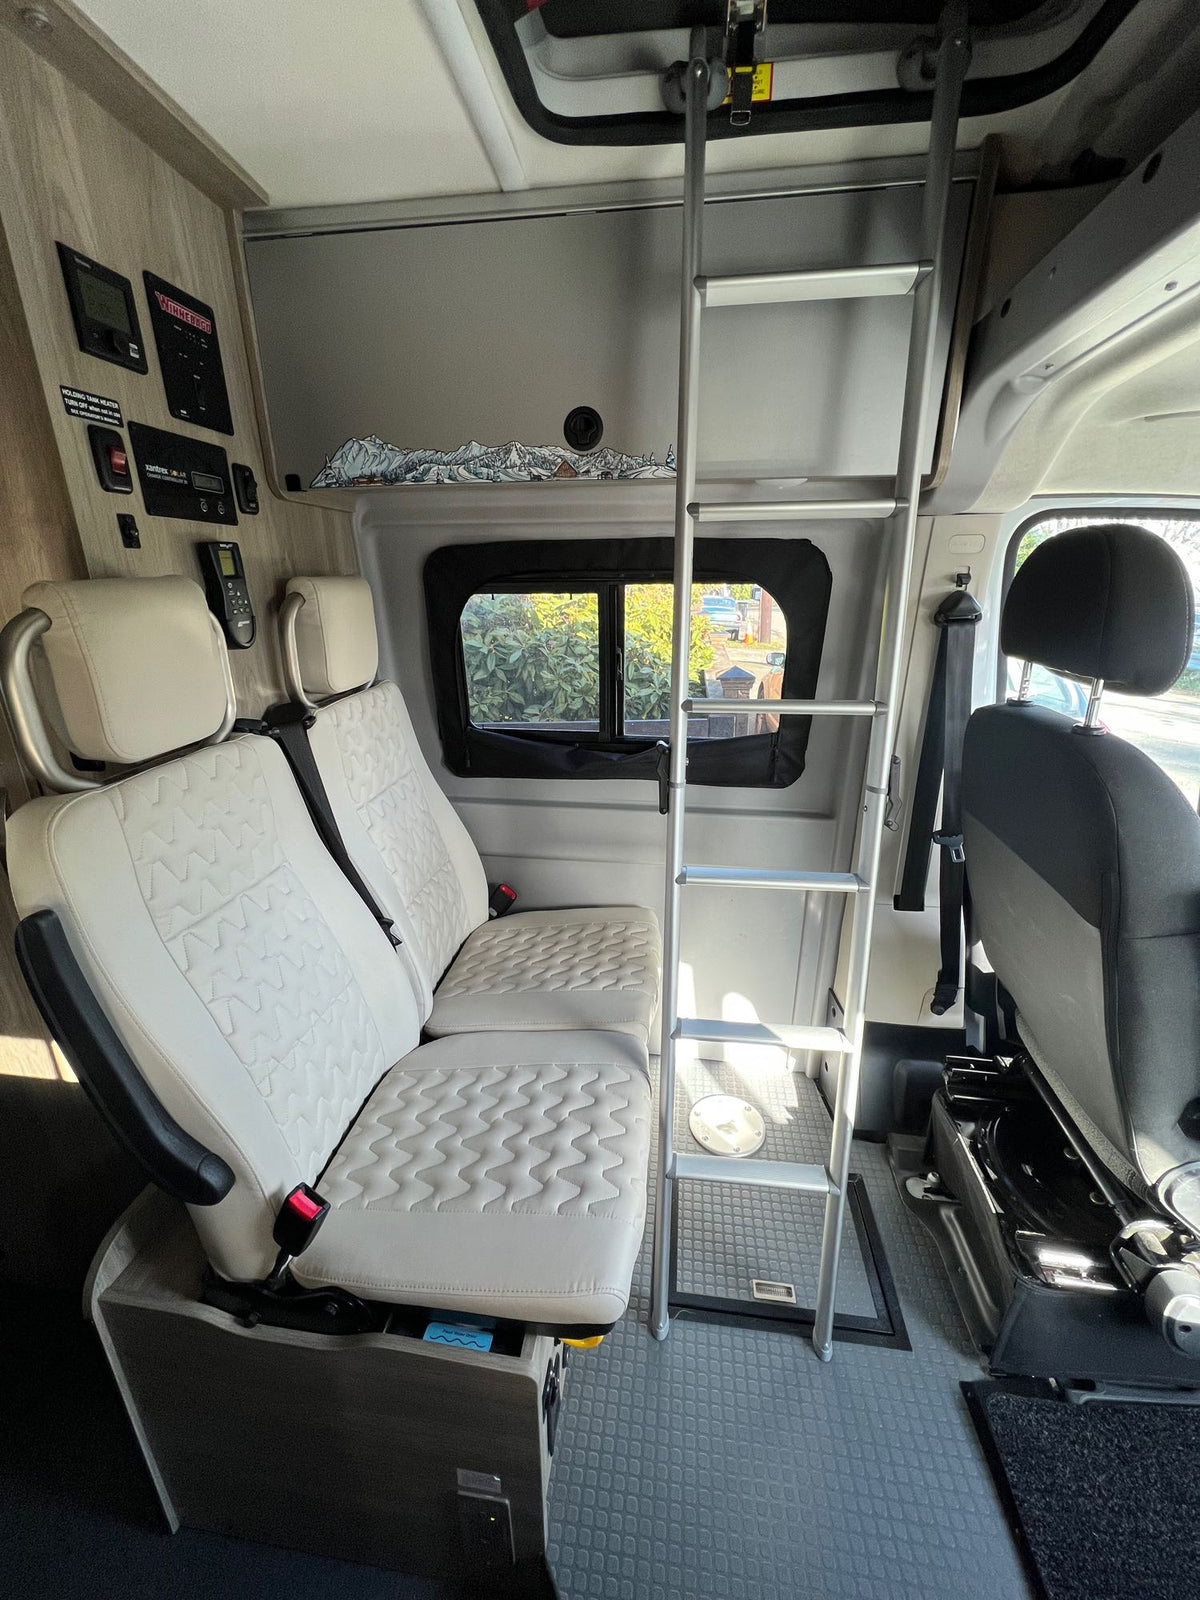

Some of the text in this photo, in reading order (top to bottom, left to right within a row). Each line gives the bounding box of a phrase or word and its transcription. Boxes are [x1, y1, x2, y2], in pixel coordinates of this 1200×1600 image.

[154, 290, 212, 334] WINNEBAGO
[61, 388, 119, 409] HOLDING TANK HEATER
[64, 397, 78, 407] TURN
[144, 463, 169, 475] xantrex
